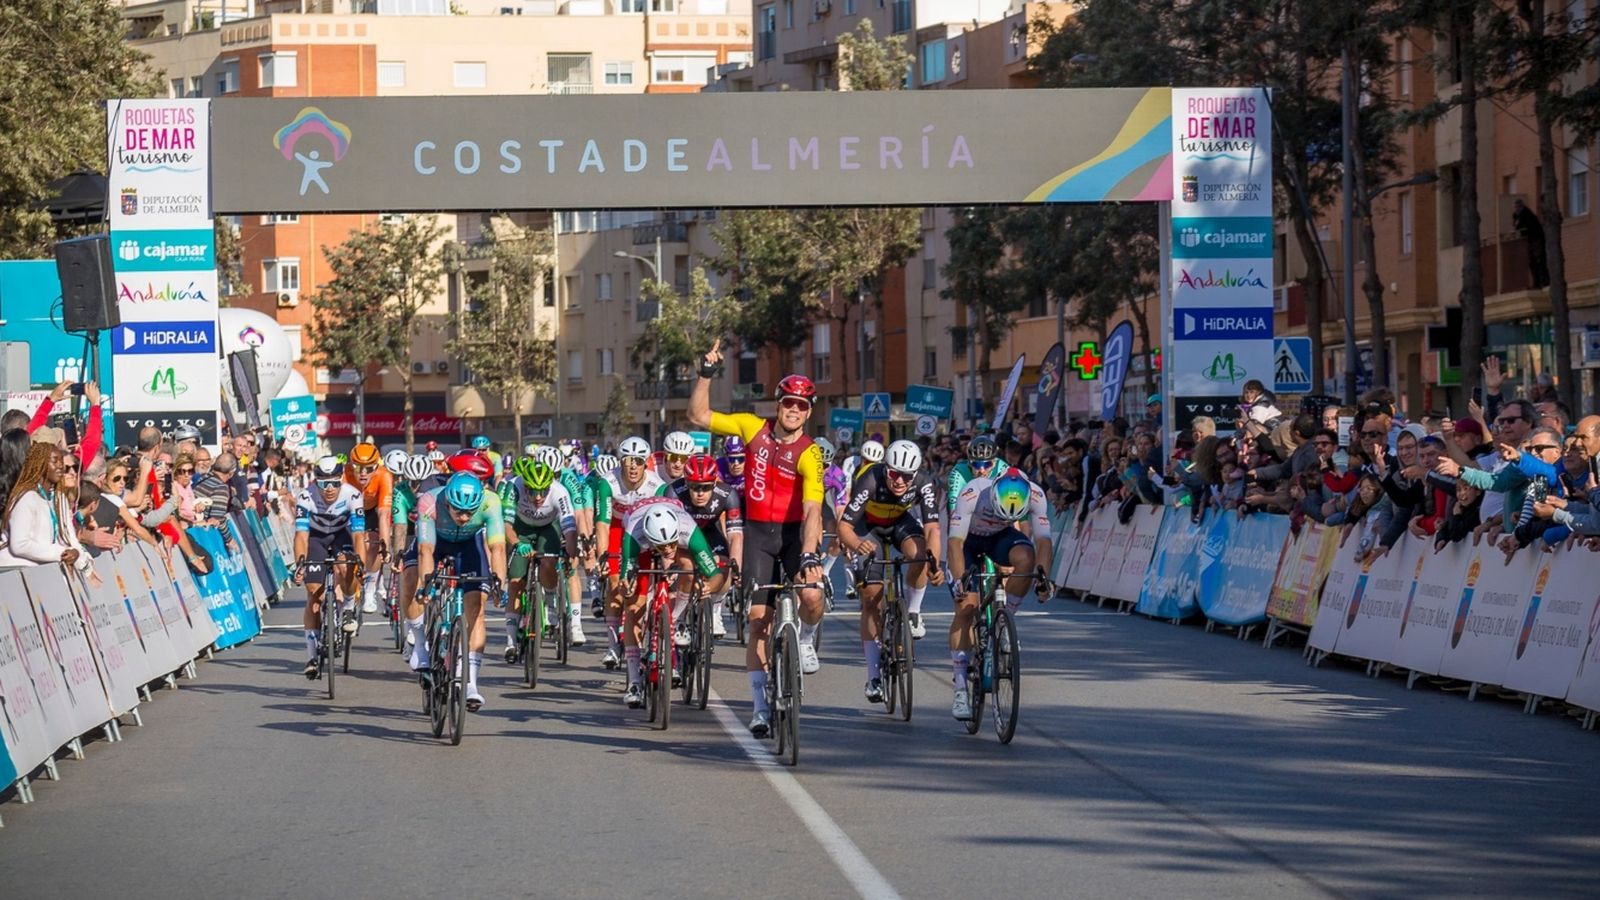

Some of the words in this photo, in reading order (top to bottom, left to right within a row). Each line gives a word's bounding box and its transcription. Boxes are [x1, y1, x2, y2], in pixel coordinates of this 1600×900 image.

[1188, 97, 1256, 114] ROQUETAS
[125, 107, 195, 125] ROQUETAS
[706, 125, 976, 171] ALMERÍA
[1179, 134, 1252, 152] turismo
[117, 146, 193, 164] turismo
[1203, 182, 1262, 193] DIPUTACIÓN
[143, 194, 202, 205] DIPUTACIÓN
[1203, 193, 1217, 202] DE
[1219, 191, 1259, 202] ALMERÍA
[143, 205, 158, 214] DE
[159, 202, 200, 214] ALMERÍA
[1203, 229, 1266, 248] cajamar
[143, 241, 208, 261] cajamar
[1178, 268, 1268, 289] Andalucía
[116, 281, 209, 304] Andalucía
[910, 399, 947, 413] cajamar
[126, 418, 206, 428] VOLVO
[276, 411, 313, 423] cajamar
[920, 420, 931, 430] 25
[290, 429, 301, 438] 25
[749, 446, 769, 502] Cofidis
